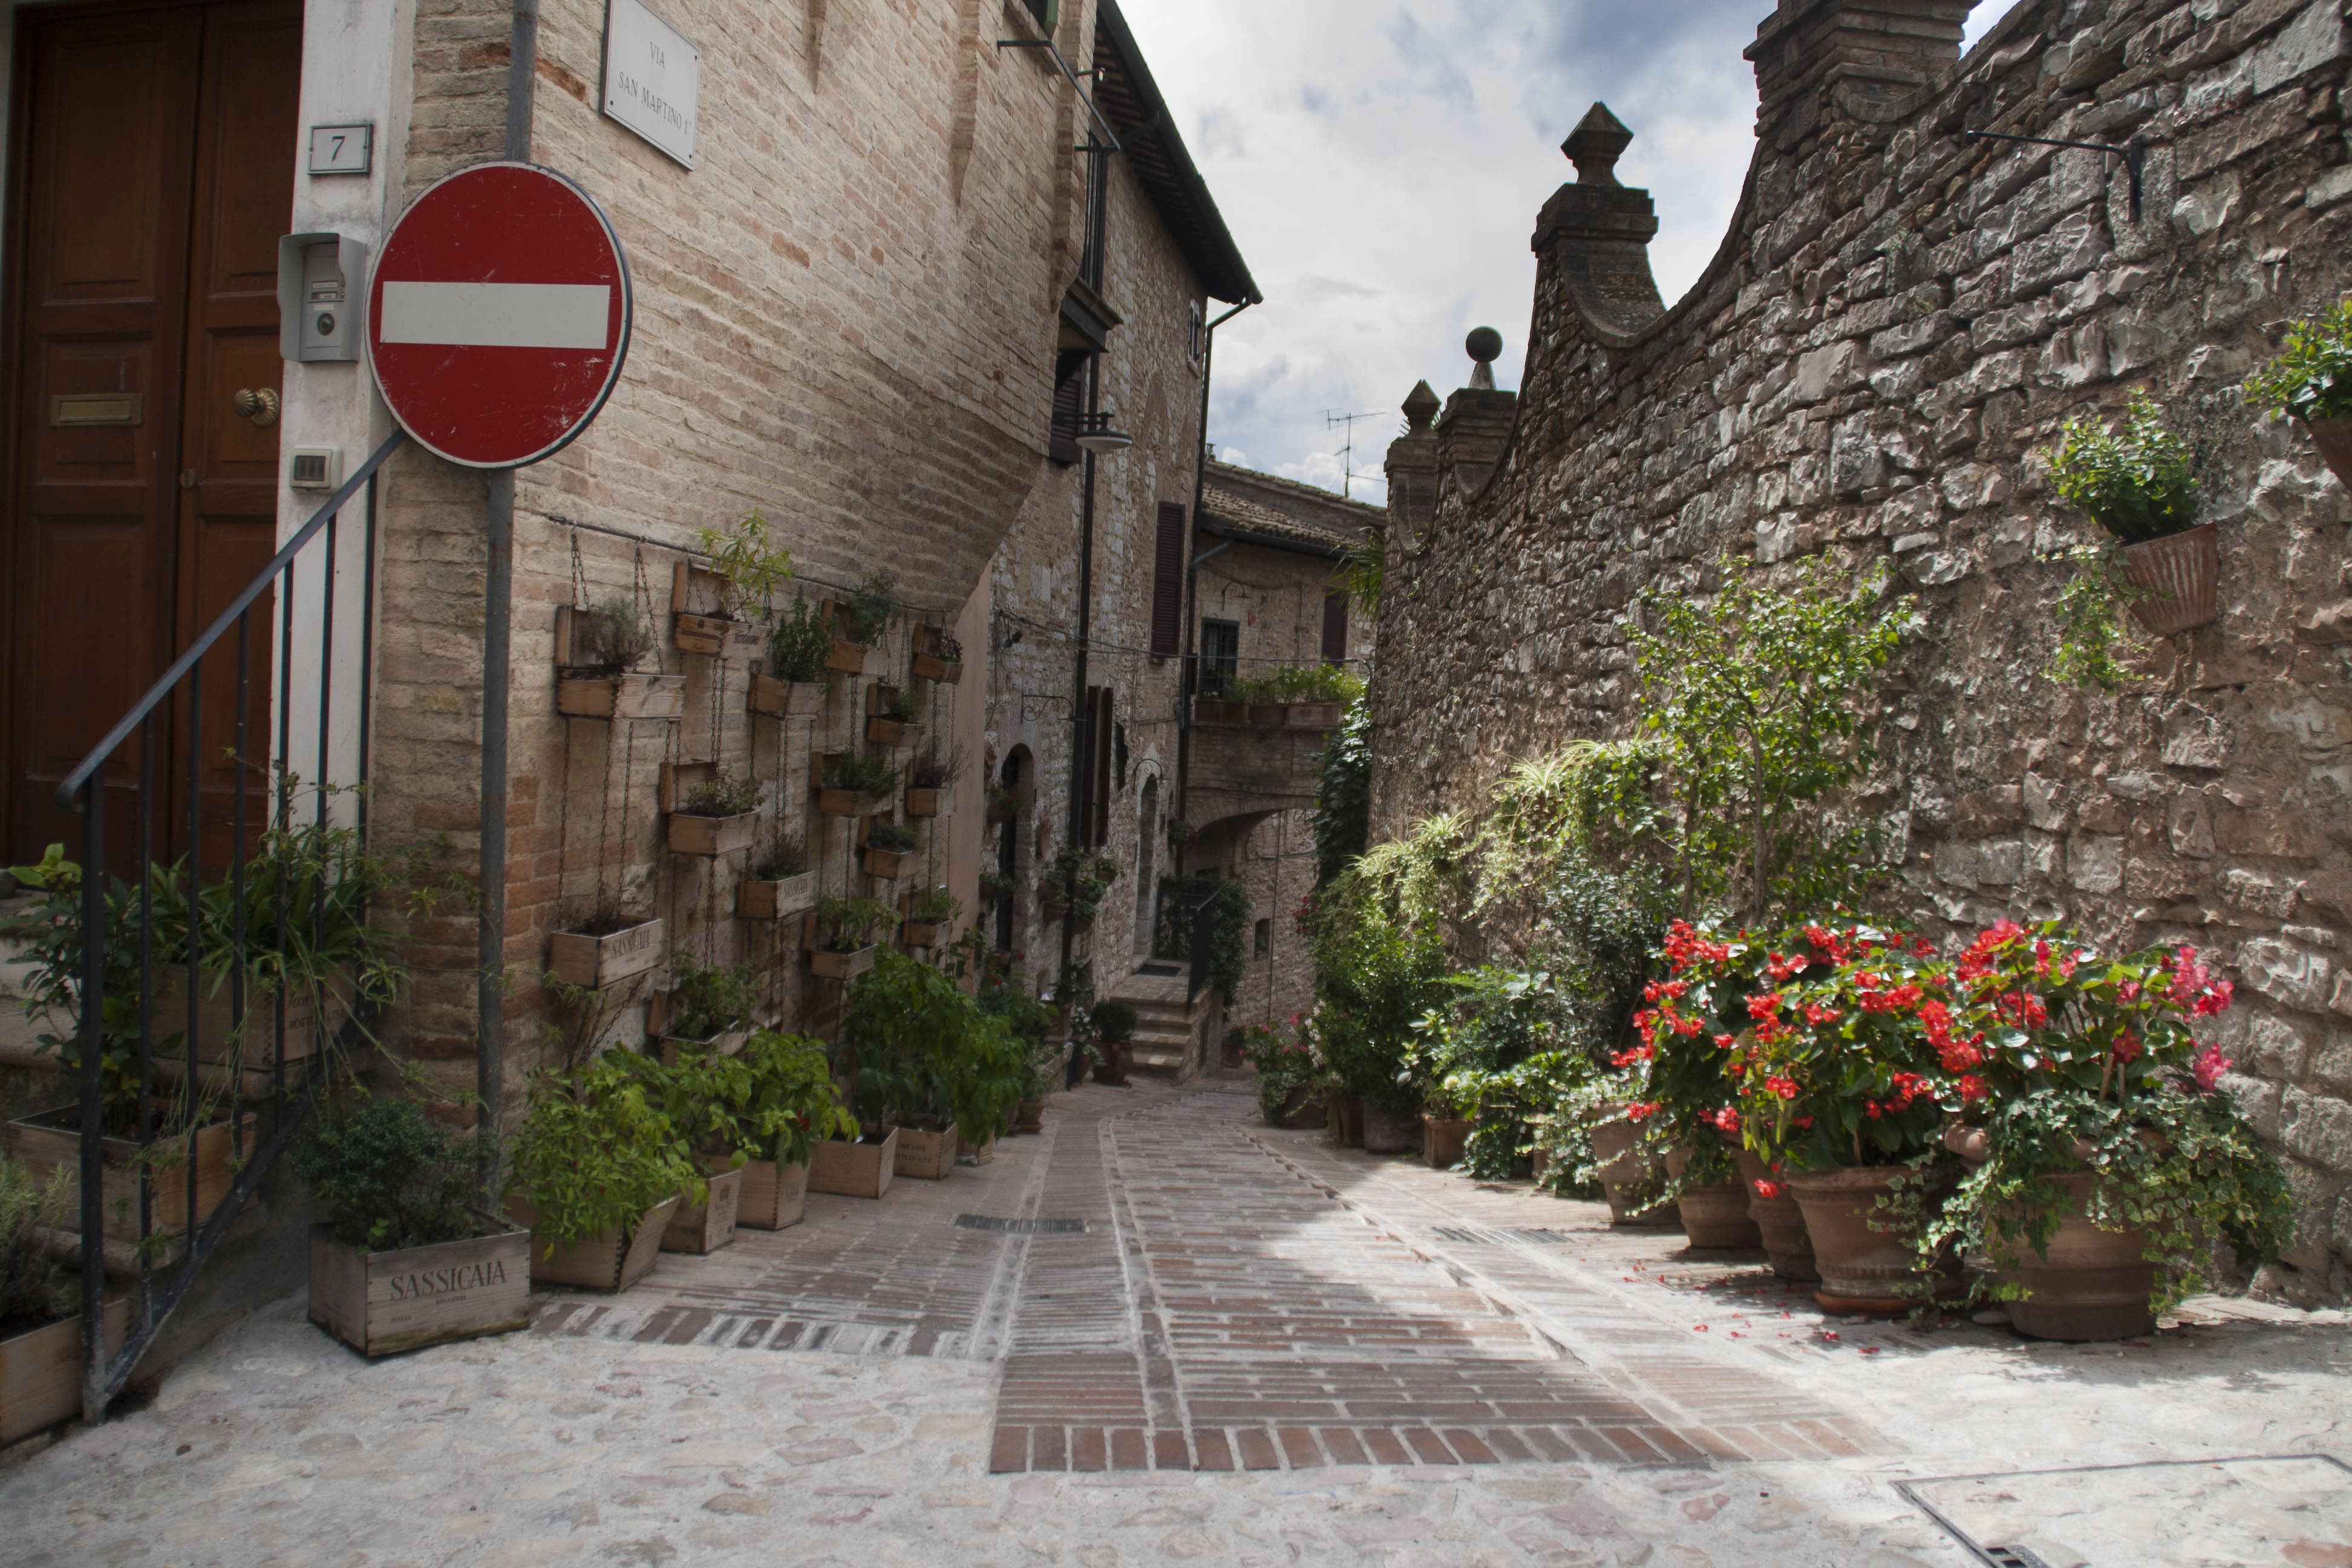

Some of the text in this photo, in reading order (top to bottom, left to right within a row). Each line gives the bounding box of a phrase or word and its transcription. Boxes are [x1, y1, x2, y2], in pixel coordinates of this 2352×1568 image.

[649, 41, 666, 69] VIA
[619, 71, 638, 97] SAN
[641, 87, 682, 129] MARTINO
[330, 136, 345, 162] 7
[391, 1261, 508, 1301] SASSICAIA
